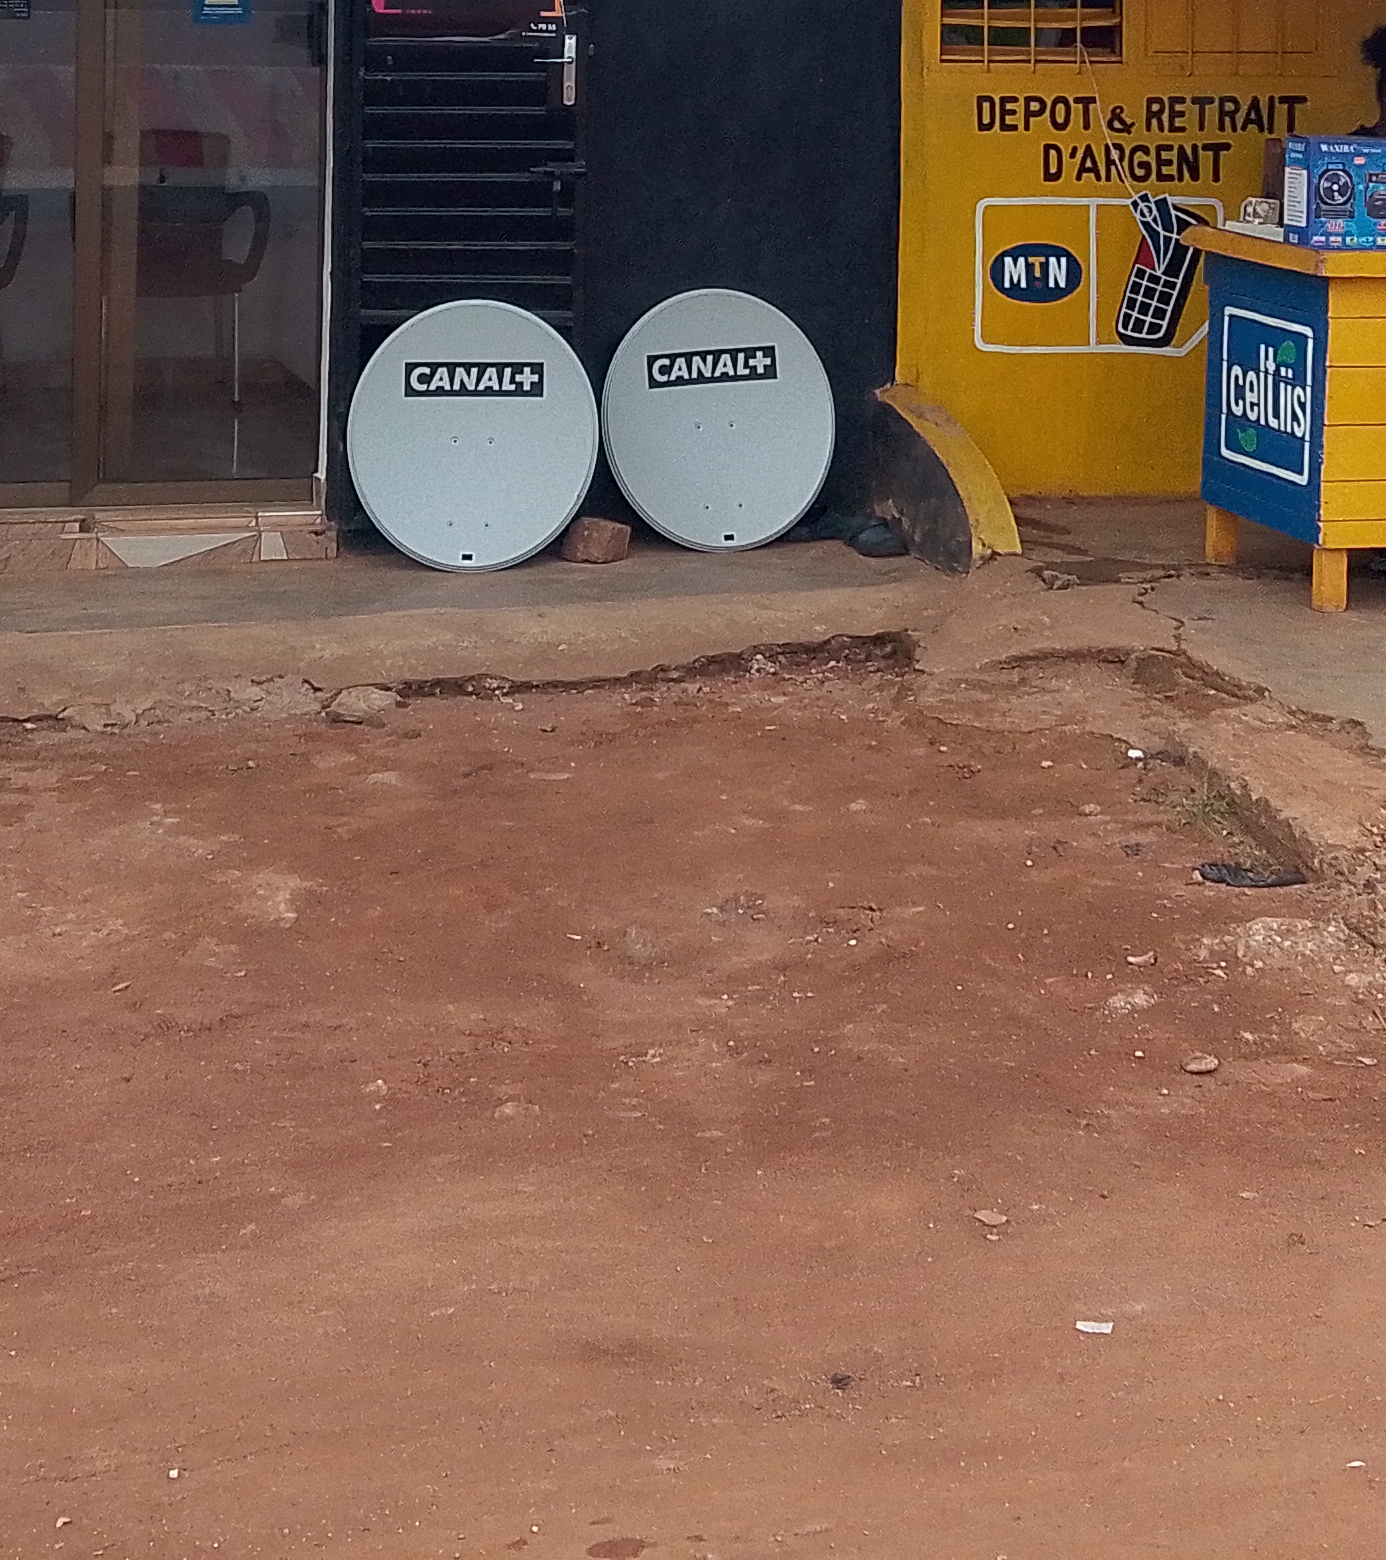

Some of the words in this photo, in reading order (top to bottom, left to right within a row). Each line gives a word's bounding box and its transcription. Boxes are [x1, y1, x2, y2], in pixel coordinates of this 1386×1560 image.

[976, 95, 1098, 132] DEPOT
[1107, 104, 1136, 135] &
[1145, 95, 1309, 136] RETRAIT
[1041, 141, 1233, 183] D'ARGENT
[1003, 256, 1067, 290] MTN
[409, 366, 540, 392] CANAL+
[651, 350, 773, 384] CANAL+
